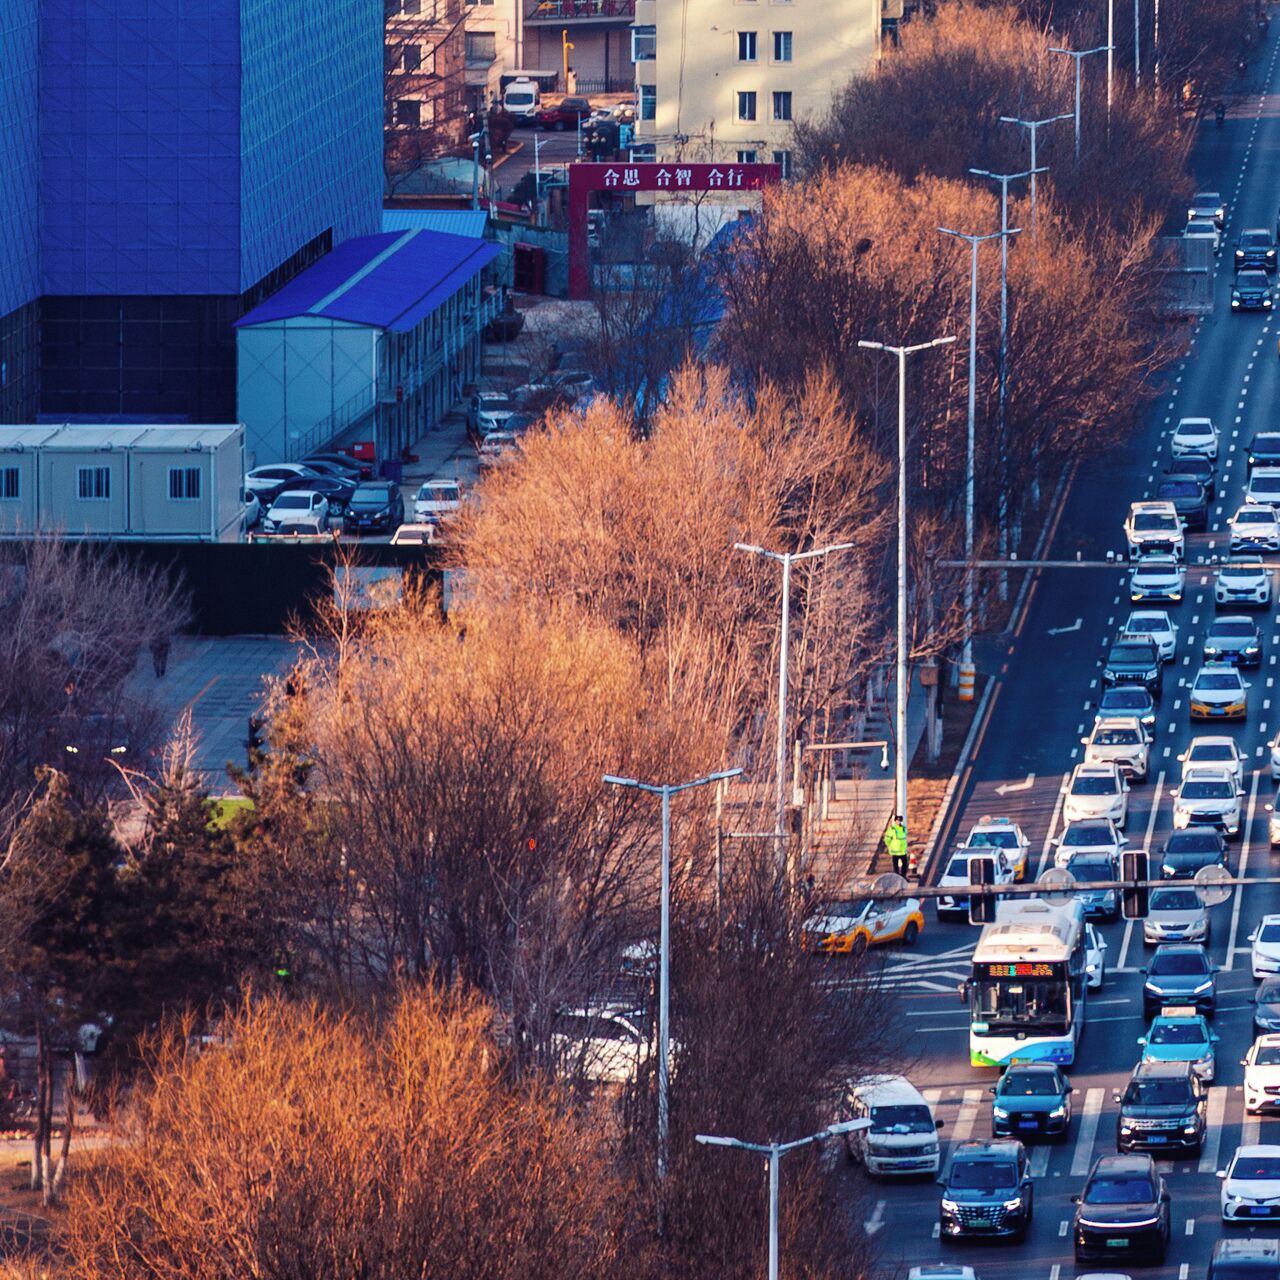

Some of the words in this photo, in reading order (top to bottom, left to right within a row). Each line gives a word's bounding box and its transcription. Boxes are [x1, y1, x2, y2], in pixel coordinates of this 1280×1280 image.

[603, 168, 641, 186] 合思
[655, 168, 693, 186] 合智
[707, 168, 744, 186] 合行
